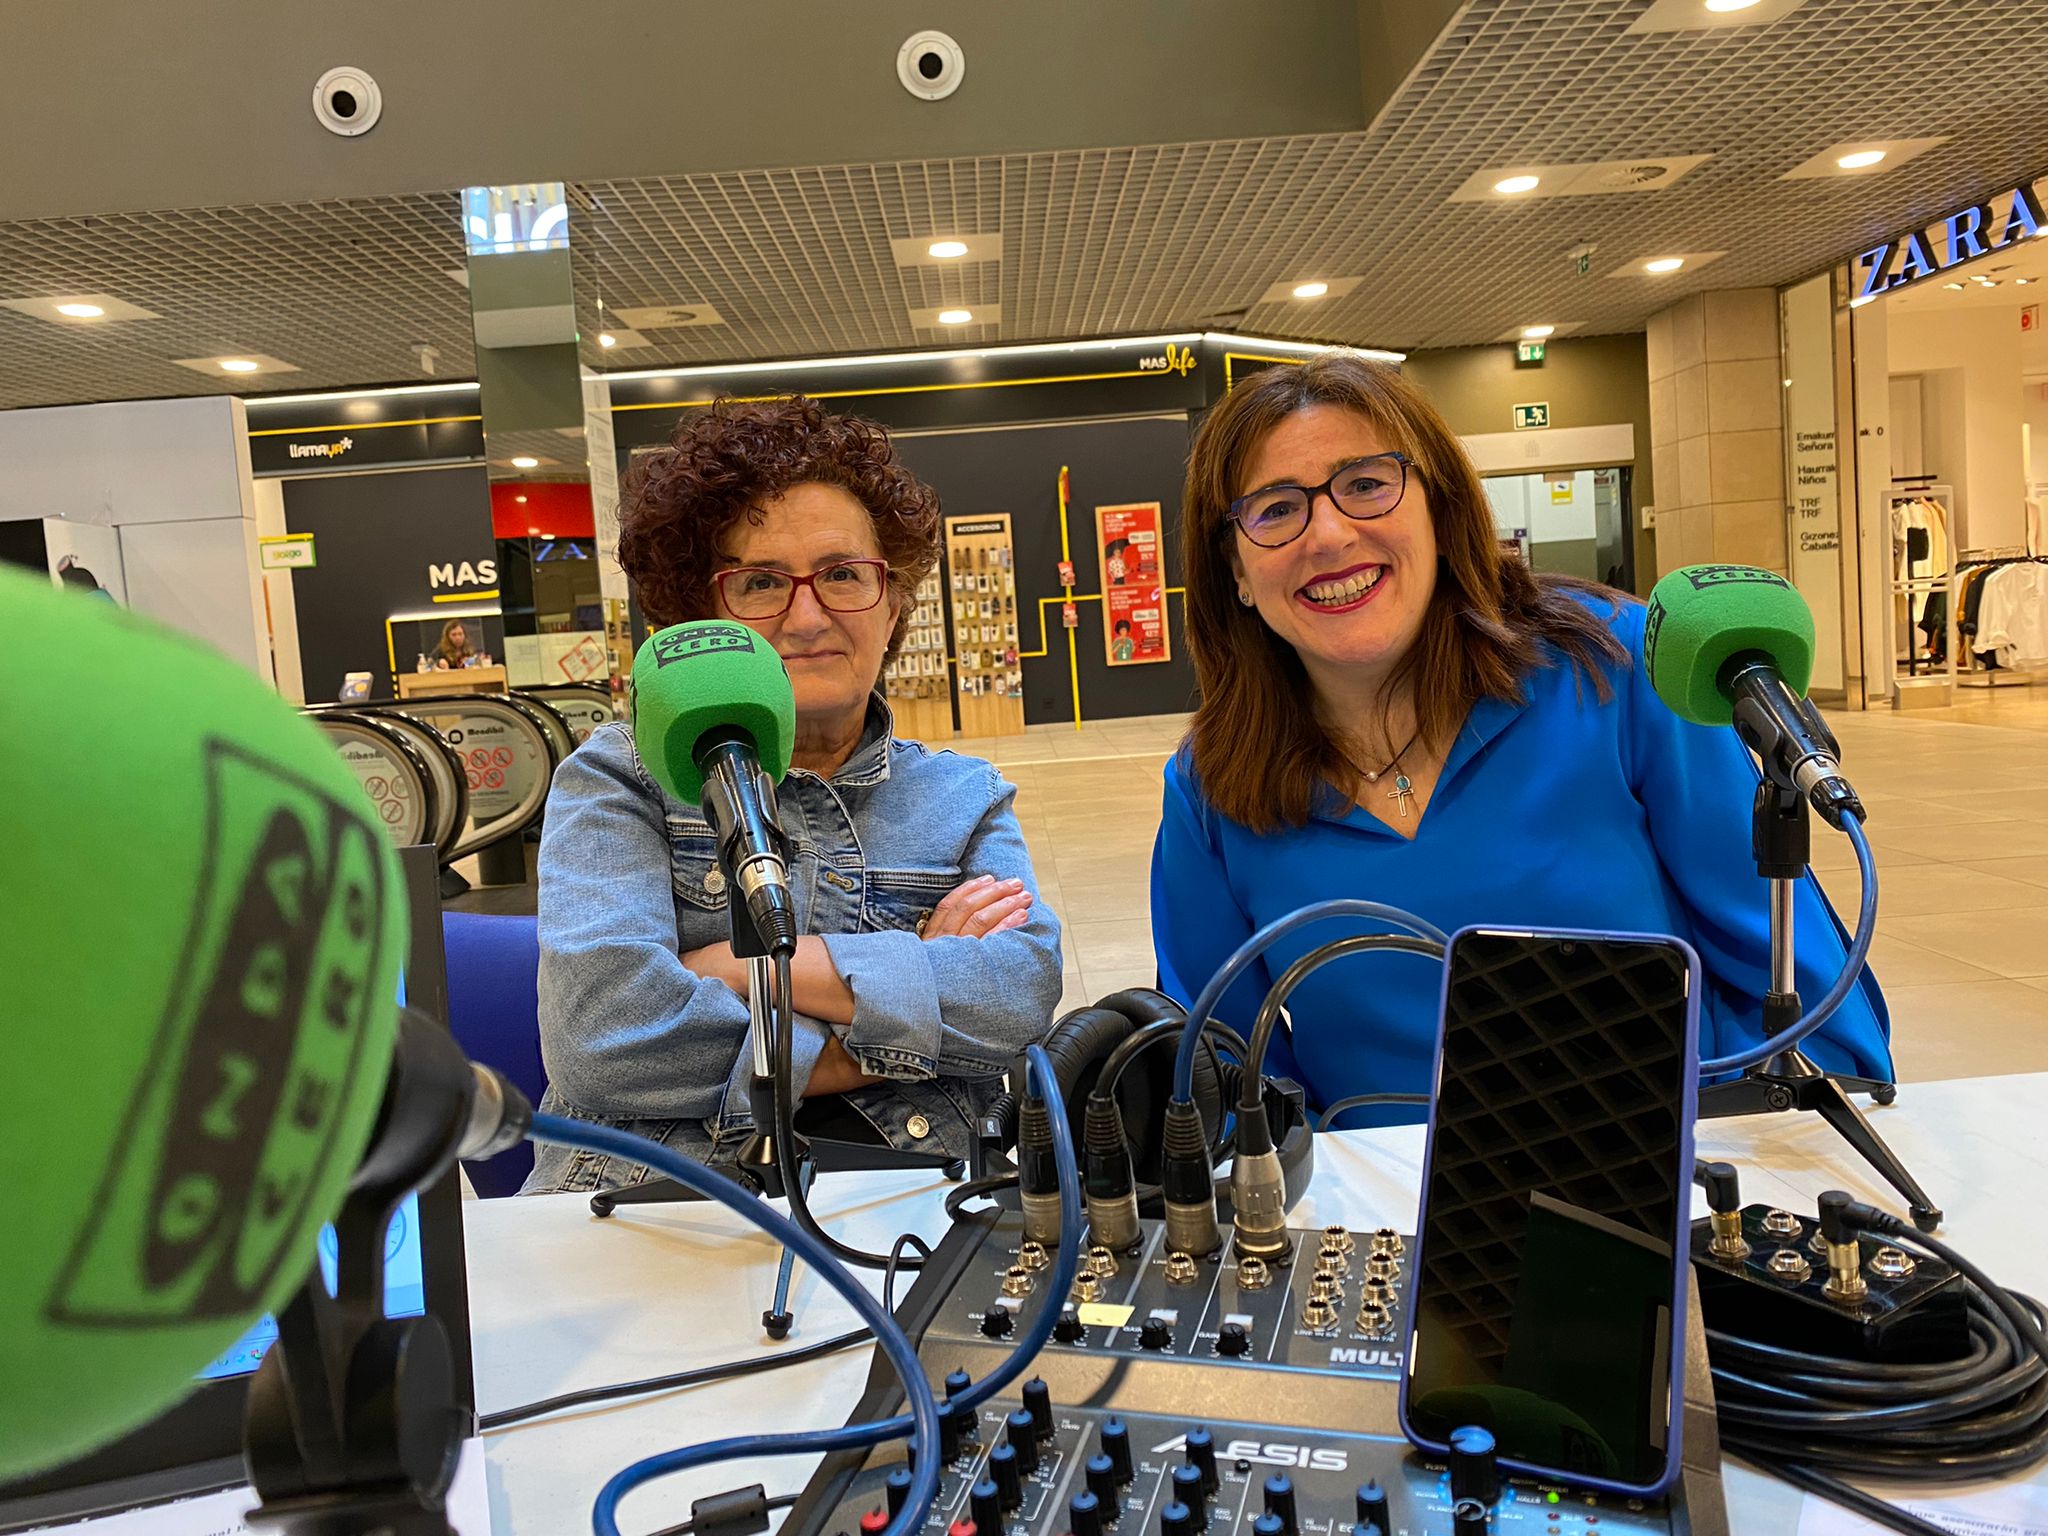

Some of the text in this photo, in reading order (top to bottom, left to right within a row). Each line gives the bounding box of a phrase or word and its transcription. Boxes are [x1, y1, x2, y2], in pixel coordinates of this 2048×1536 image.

[1859, 188, 2042, 297] ZARA
[1140, 343, 1198, 377] MAS life
[1797, 442, 1833, 452] Señora
[1798, 476, 1827, 485] Niños
[1800, 498, 1820, 508] TRF
[1800, 509, 1820, 519] TRF
[429, 560, 498, 589] MAS
[1709, 571, 1772, 580] CERO
[664, 628, 734, 643] ONDA
[672, 638, 738, 654] CERO
[158, 851, 308, 1244] ONDA
